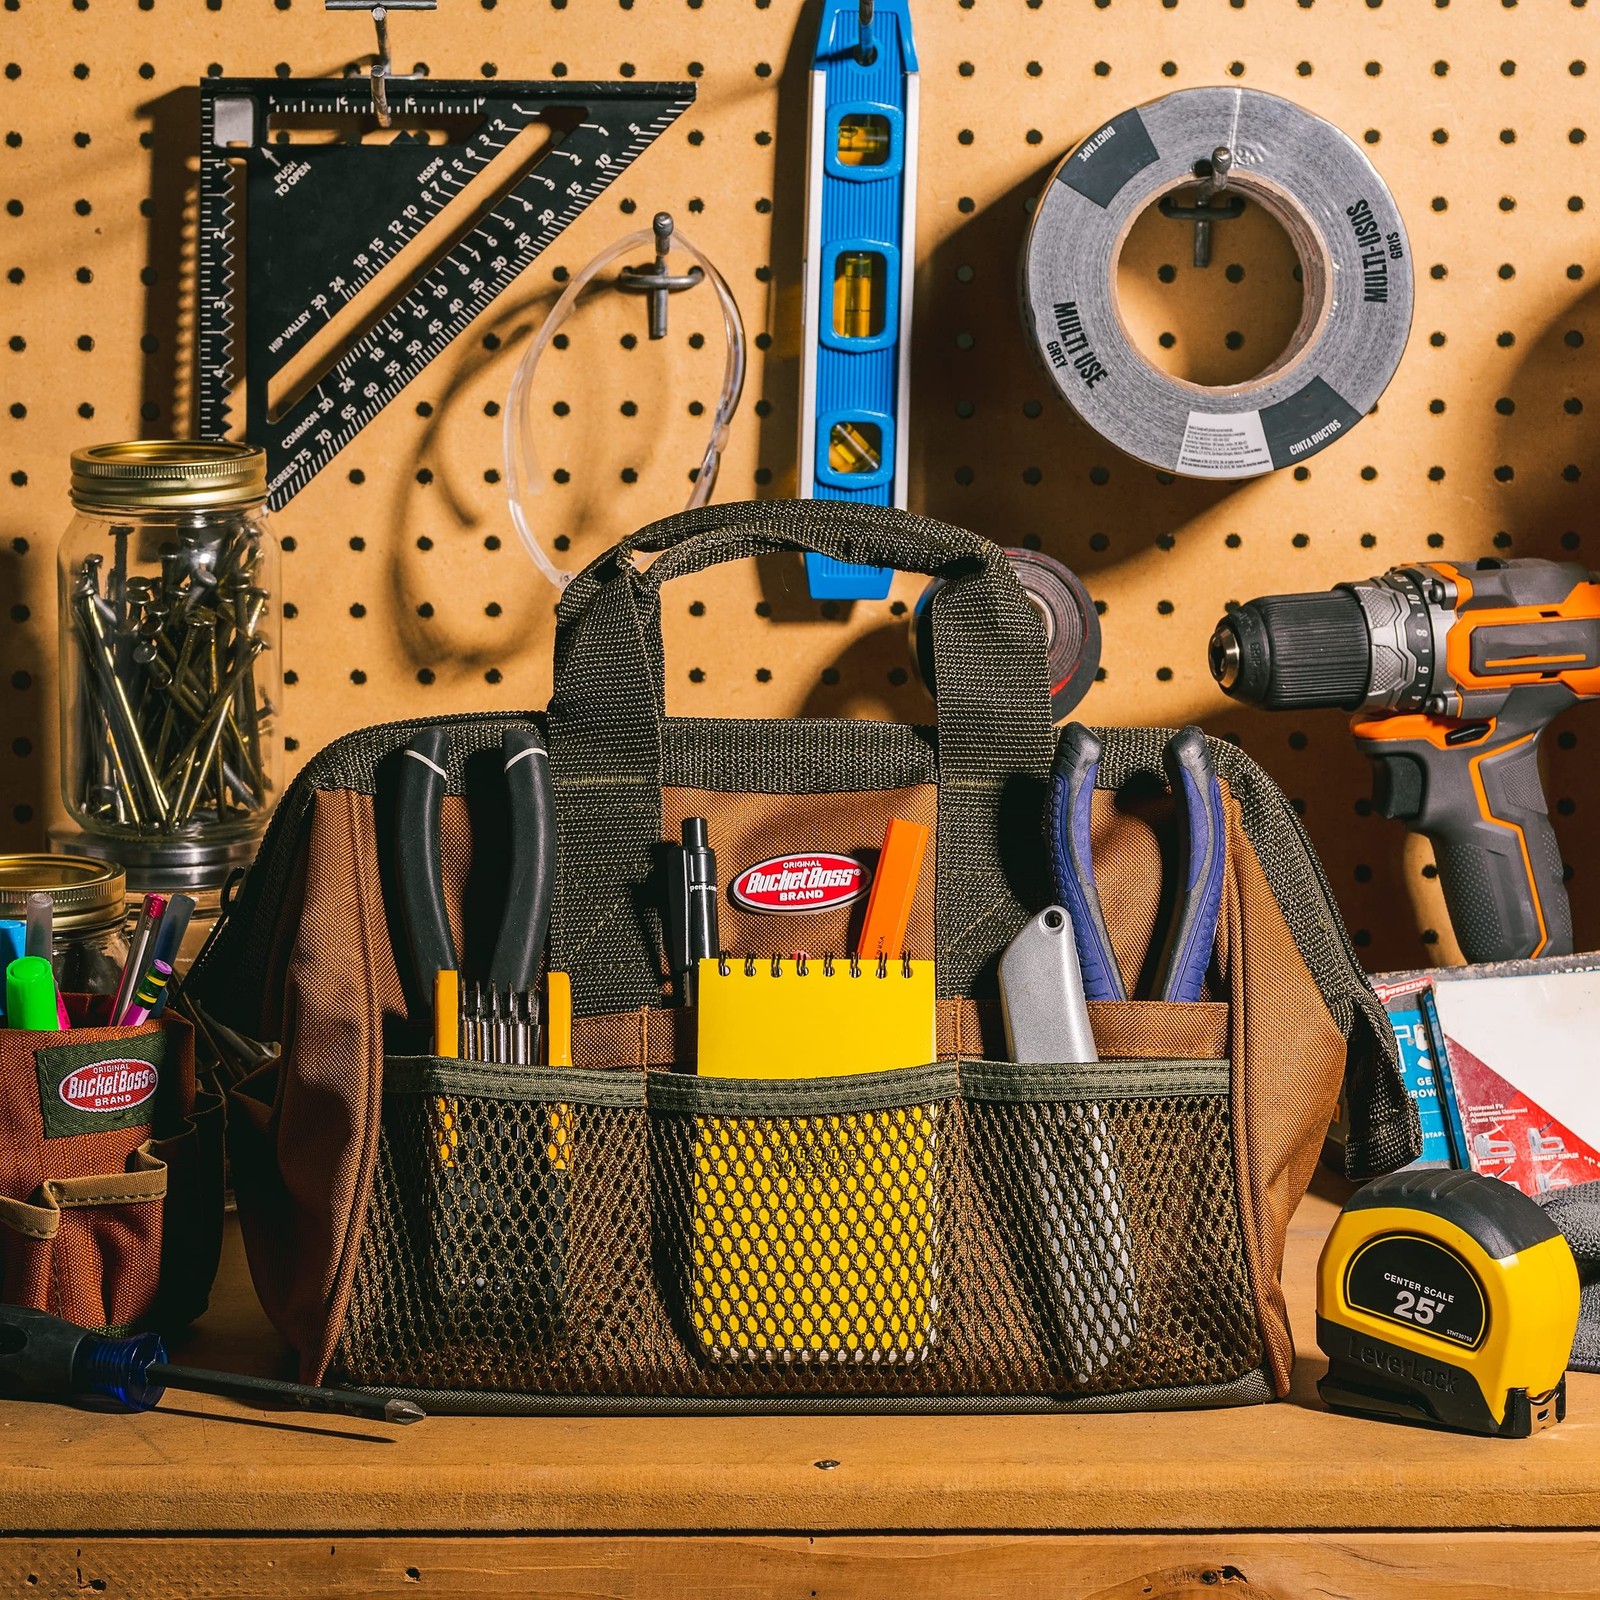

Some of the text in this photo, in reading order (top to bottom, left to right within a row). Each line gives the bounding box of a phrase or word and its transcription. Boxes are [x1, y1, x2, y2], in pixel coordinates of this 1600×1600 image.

[1078, 126, 1116, 162] DUCT TAPE
[215, 160, 227, 169] 1
[274, 160, 298, 184] PUSH
[274, 161, 312, 197] TO OPEN
[213, 230, 226, 240] 2
[268, 102, 524, 353] HIP VALLEY 30 24 18 15 12 10 8 7 6 5 4 3 2 1
[1346, 199, 1388, 304] MULTI-USOS
[1386, 232, 1404, 260] GRIS
[280, 126, 610, 450] COMMON 30 24 18 15 12 10 8 7 6 5 4 3 2 1
[294, 448, 312, 465] 75
[314, 428, 333, 447] 70
[340, 404, 358, 421] 65
[363, 381, 380, 399] 60
[384, 360, 401, 378] 55
[406, 339, 424, 357] 50
[428, 318, 444, 336] 45
[448, 298, 464, 315] 40
[468, 278, 486, 295] 35
[490, 255, 508, 272] 30
[514, 232, 532, 250] 25
[538, 208, 556, 226] 20
[566, 181, 584, 198] 15
[595, 152, 612, 169] 10
[628, 122, 641, 135] 5
[213, 300, 226, 310] 3
[1046, 340, 1068, 368] GREY
[1054, 302, 1108, 390] MULTI USE
[213, 369, 225, 379] 4
[1290, 418, 1342, 456] CINTA DUCTOS
[1407, 594, 1422, 605] 10
[1416, 629, 1428, 637] 8
[1418, 666, 1430, 674] 6
[783, 860, 822, 869] ORIGINAL
[780, 890, 824, 902] BRAND
[1375, 980, 1427, 1000] ARROW
[93, 1064, 130, 1074] ORIGINAL
[96, 1094, 132, 1106] BRAND
[1384, 1272, 1454, 1304] CENTER SCALE
[1393, 1290, 1446, 1325] 25'
